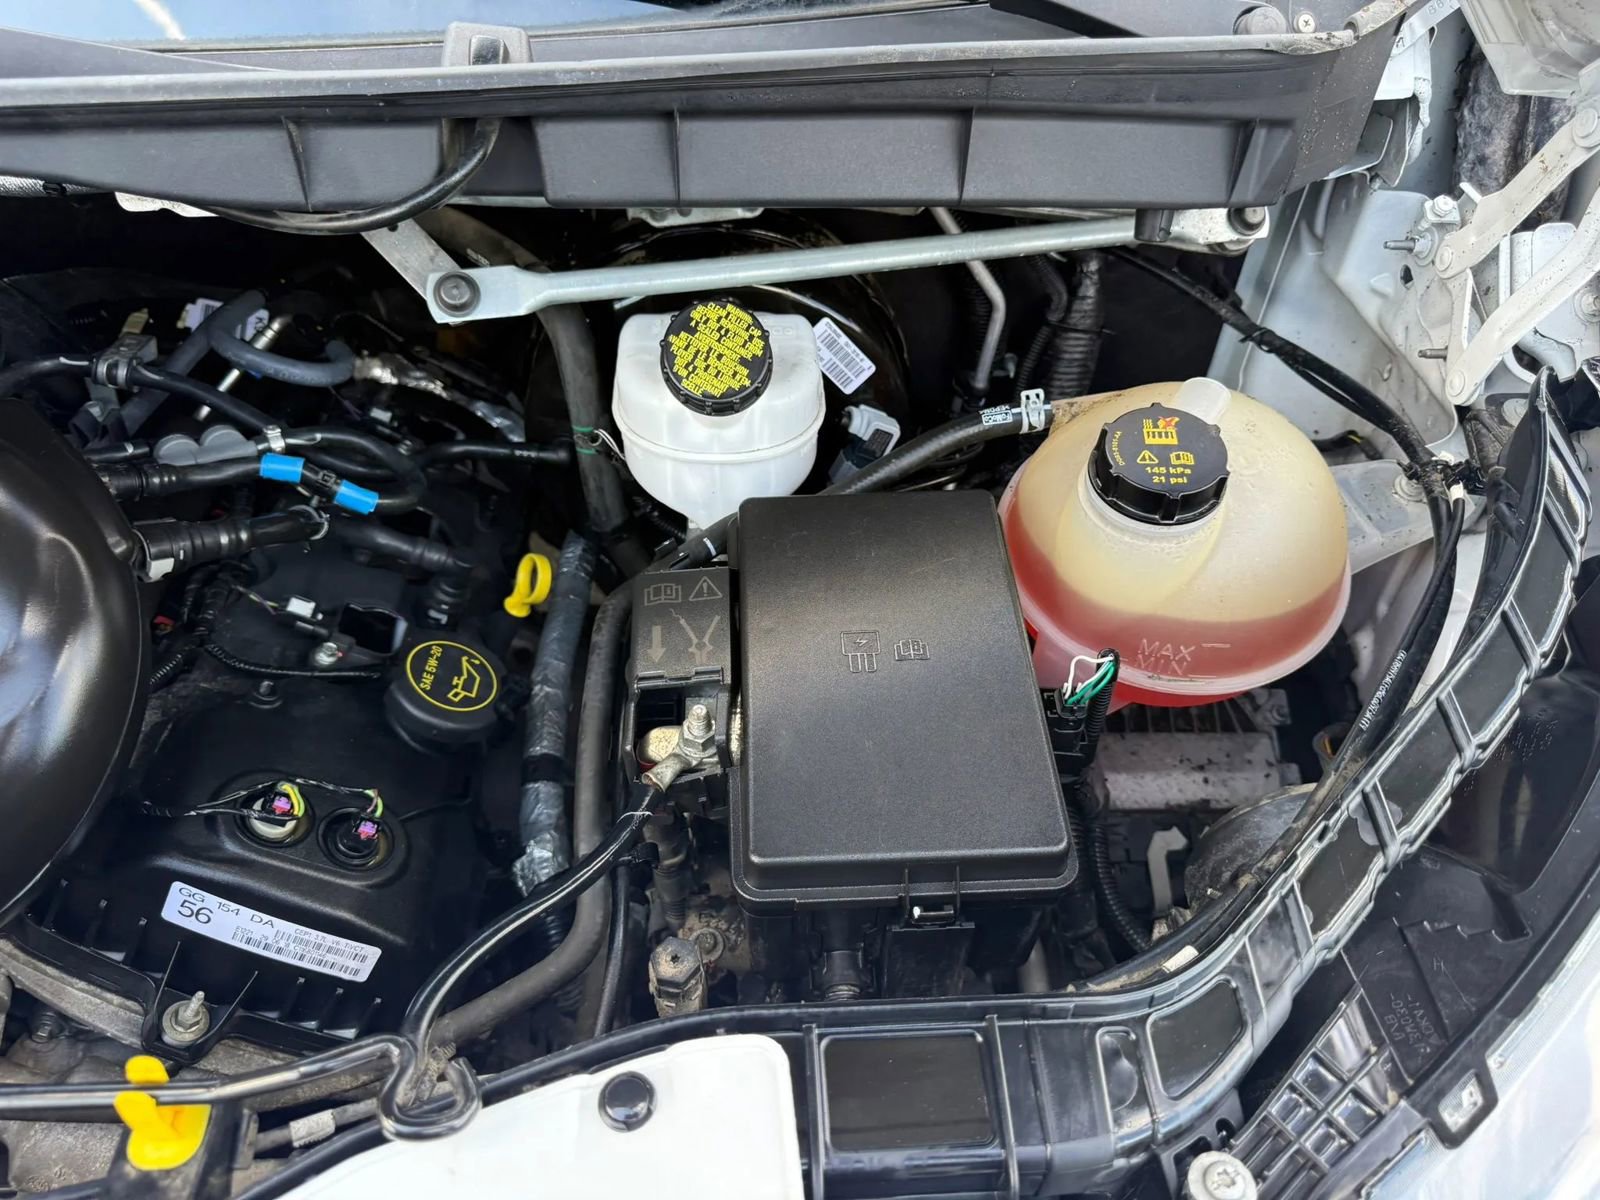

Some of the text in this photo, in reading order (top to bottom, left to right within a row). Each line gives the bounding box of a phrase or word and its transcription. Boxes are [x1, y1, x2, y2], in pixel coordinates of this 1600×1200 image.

[696, 304, 719, 322] BEFORE
[752, 337, 765, 349] USE
[707, 302, 727, 317] CLEAN
[728, 314, 748, 330] FILLER
[749, 326, 762, 338] CAP
[690, 310, 707, 324] ONLY
[707, 320, 720, 331] DOT
[727, 331, 744, 346] FLUID
[745, 342, 763, 357] FROM
[697, 323, 720, 341] SEALED
[720, 355, 749, 376] BOUCHON
[718, 372, 741, 390] LIQUIDE
[1170, 476, 1188, 484] psi
[1138, 638, 1196, 661] MAX
[420, 645, 443, 690] SAE 5W-20
[1134, 654, 1187, 676] MIN
[177, 900, 214, 924] 56
[178, 886, 275, 928] GG 154 DA
